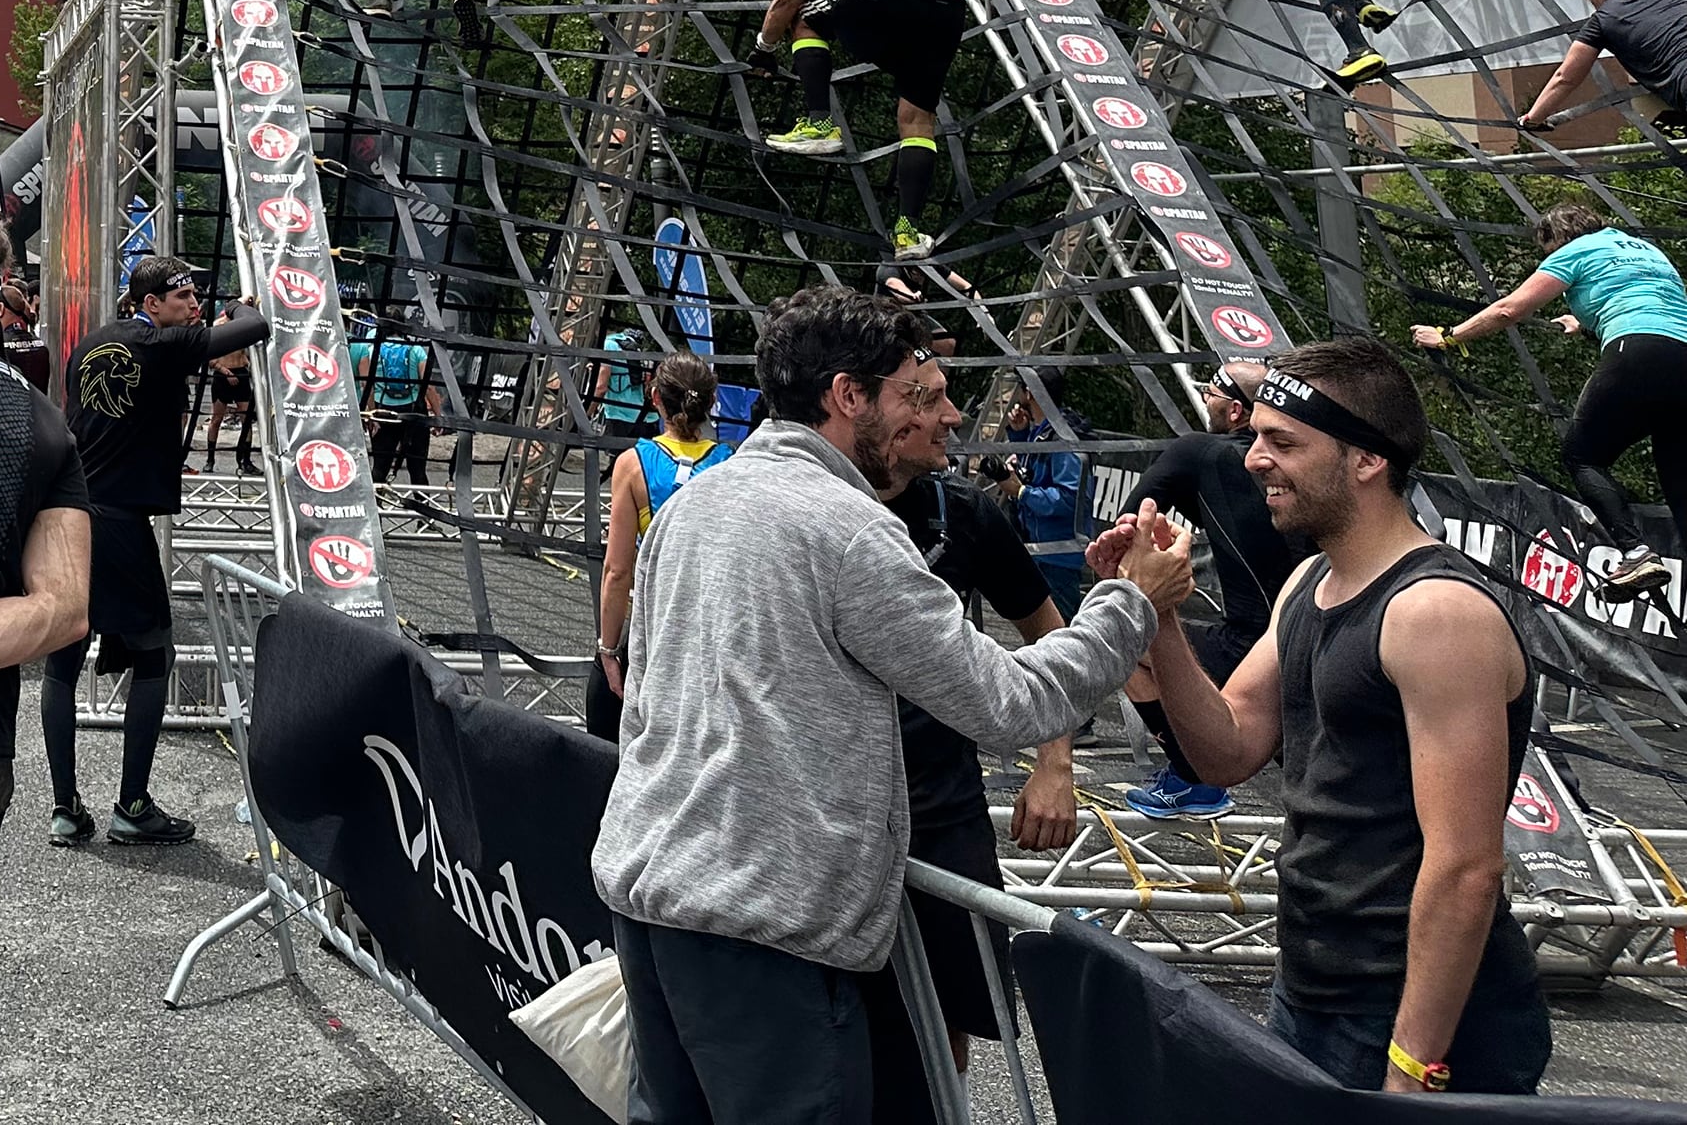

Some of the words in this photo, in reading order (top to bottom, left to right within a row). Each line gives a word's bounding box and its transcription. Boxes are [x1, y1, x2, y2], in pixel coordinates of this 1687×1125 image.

[1052, 14, 1092, 25] SPARTAN
[1086, 75, 1127, 85] SPARTAN
[1124, 140, 1168, 151] SPARTAN
[1164, 208, 1208, 221] SPARTAN
[1204, 278, 1221, 286] NOT
[1222, 280, 1252, 290] TOUCH!
[1217, 287, 1254, 298] PENALTY!
[3, 340, 45, 349] FINISHE
[283, 402, 296, 410] DO
[314, 504, 366, 519] SPARTAN
[1519, 852, 1537, 862] DO
[1537, 851, 1557, 861] NOT
[1524, 860, 1556, 872] 10min
